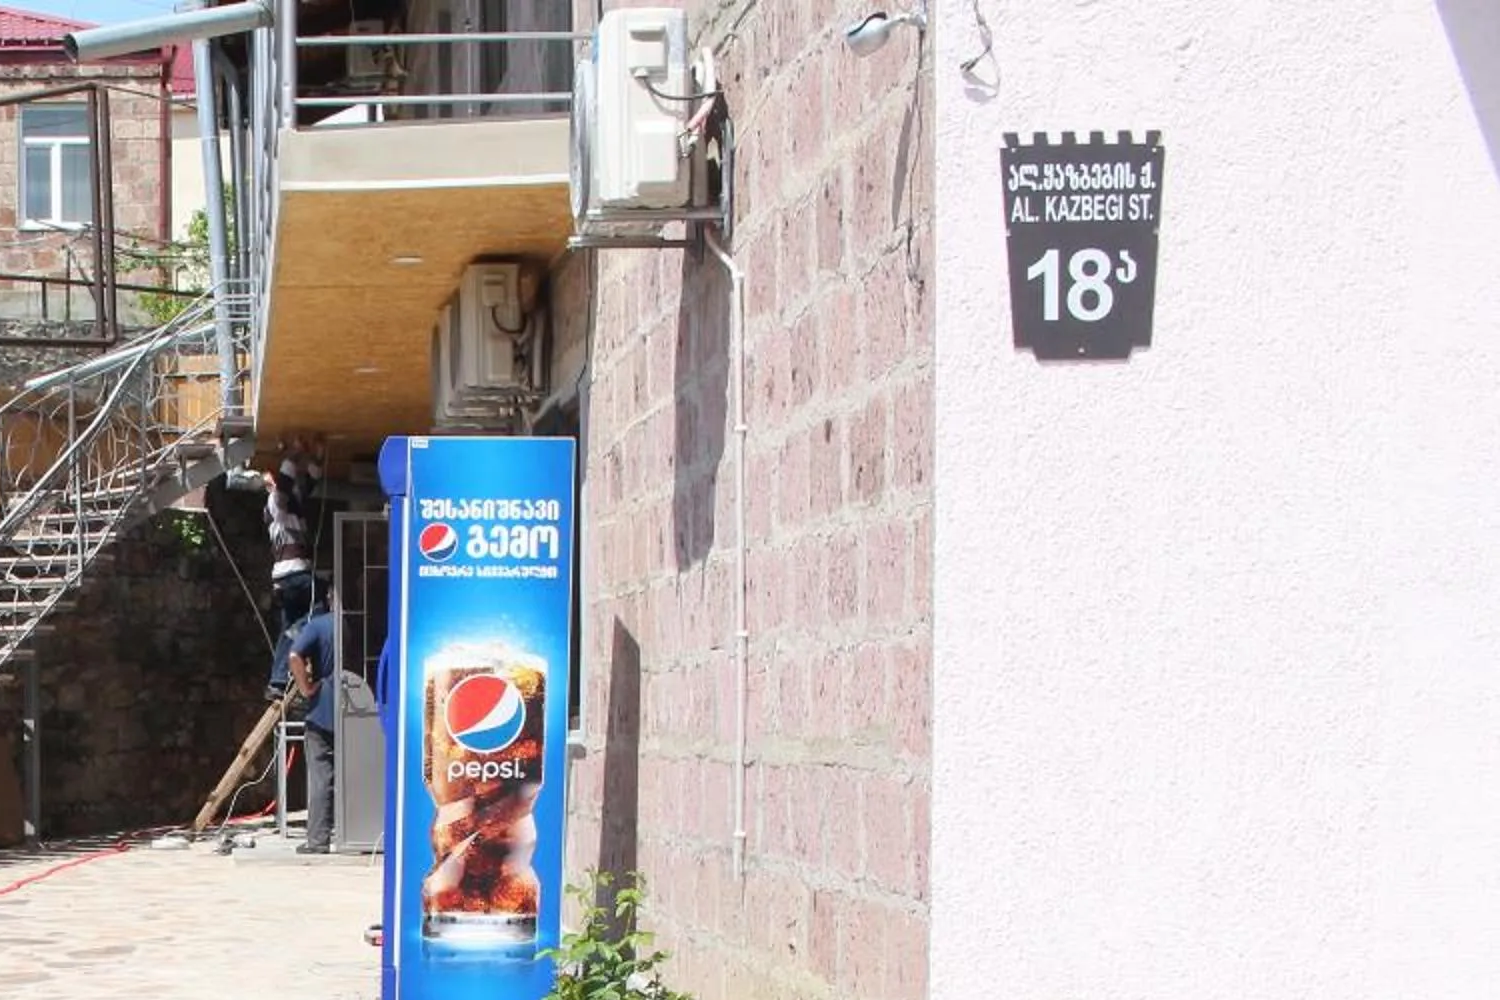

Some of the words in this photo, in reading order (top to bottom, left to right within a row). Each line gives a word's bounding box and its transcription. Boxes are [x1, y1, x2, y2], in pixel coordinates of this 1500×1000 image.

[1011, 196, 1039, 223] AL.
[1045, 195, 1123, 221] KAZBEGI
[1128, 193, 1154, 220] ST.
[419, 499, 560, 521] შესანიშნავი
[466, 524, 560, 560] გემო
[447, 757, 521, 783] pepsi
